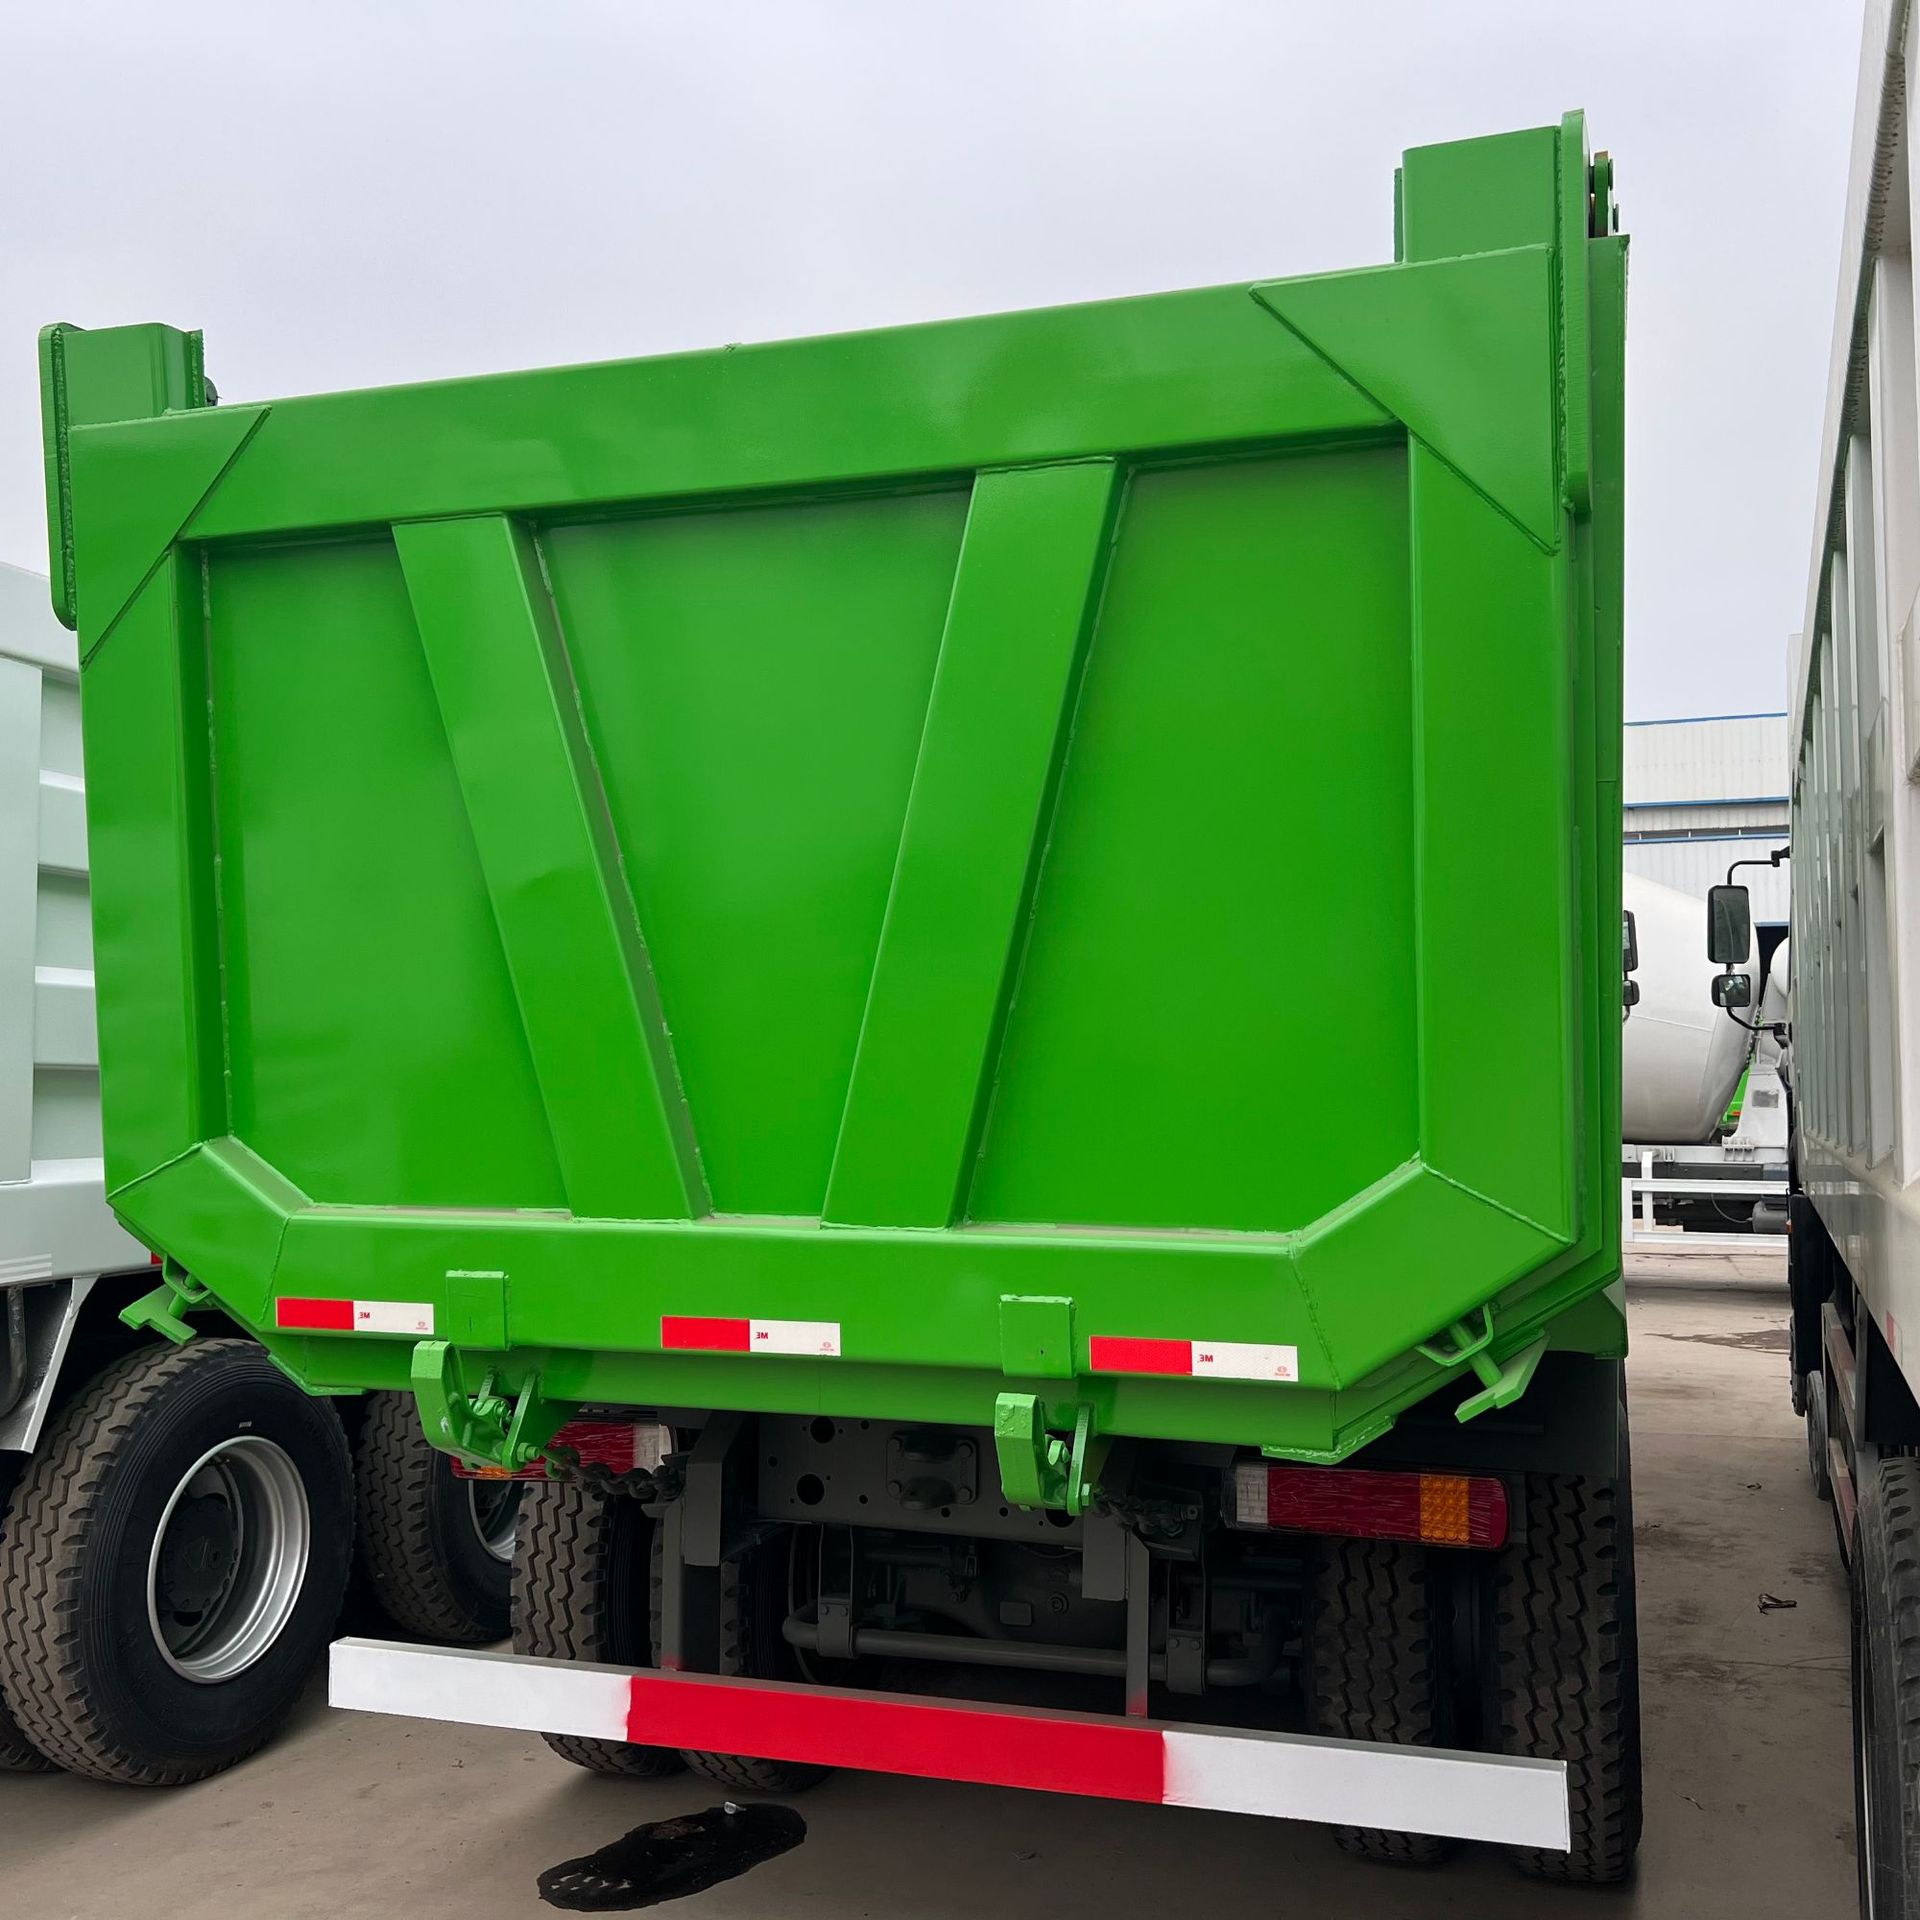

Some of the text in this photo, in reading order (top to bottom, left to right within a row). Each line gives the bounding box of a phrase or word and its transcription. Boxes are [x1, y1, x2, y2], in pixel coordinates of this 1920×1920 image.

[359, 1311, 371, 1319] 3M
[756, 1331, 769, 1340] 3M
[1199, 1354, 1214, 1363] 3M
